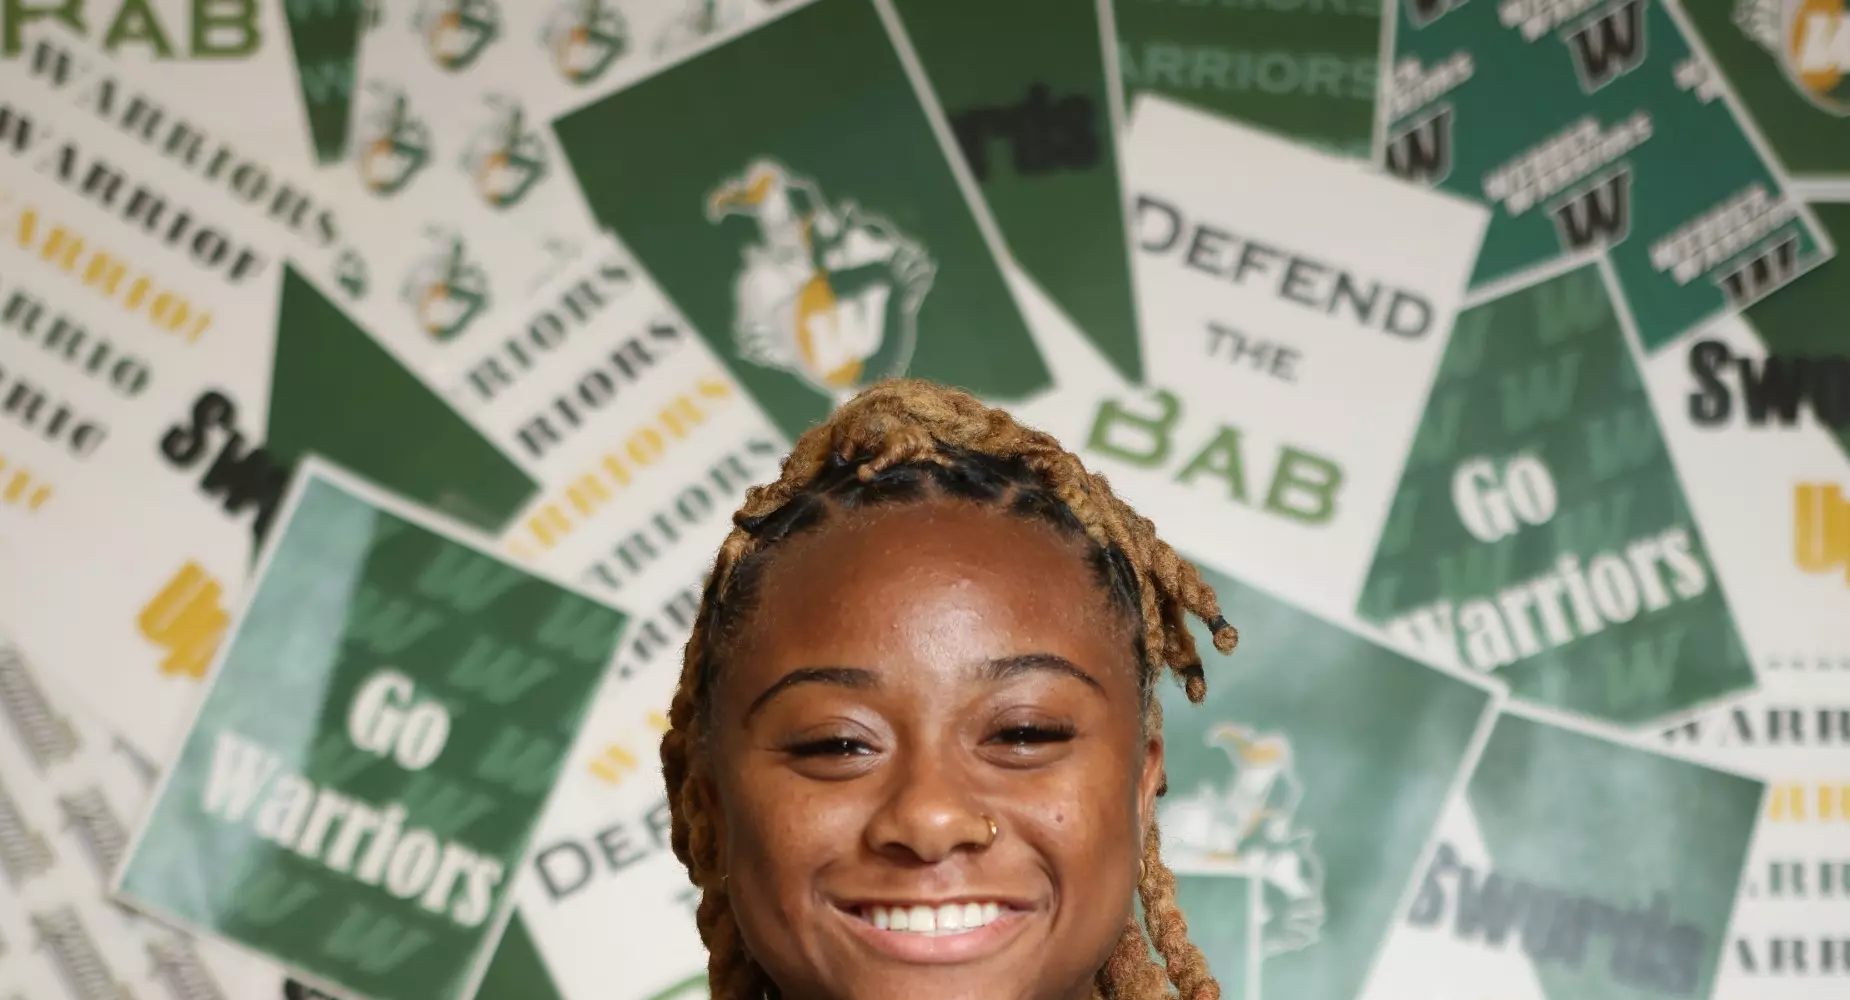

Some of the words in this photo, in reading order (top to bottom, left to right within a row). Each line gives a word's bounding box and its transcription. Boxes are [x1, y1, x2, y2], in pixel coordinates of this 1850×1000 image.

[30, 40, 338, 247] WARRIORS
[0, 207, 213, 344] ARRIO
[464, 260, 634, 402] RIORS
[1136, 195, 1435, 342] DEFEND
[0, 290, 151, 398] RRIO
[515, 316, 682, 460] RIORS
[1206, 322, 1303, 383] THE
[1087, 389, 1344, 527] BAB
[1451, 452, 1558, 544] Go
[1386, 527, 1708, 675] Warriors
[346, 666, 452, 772] Go
[203, 730, 505, 930] Warriors
